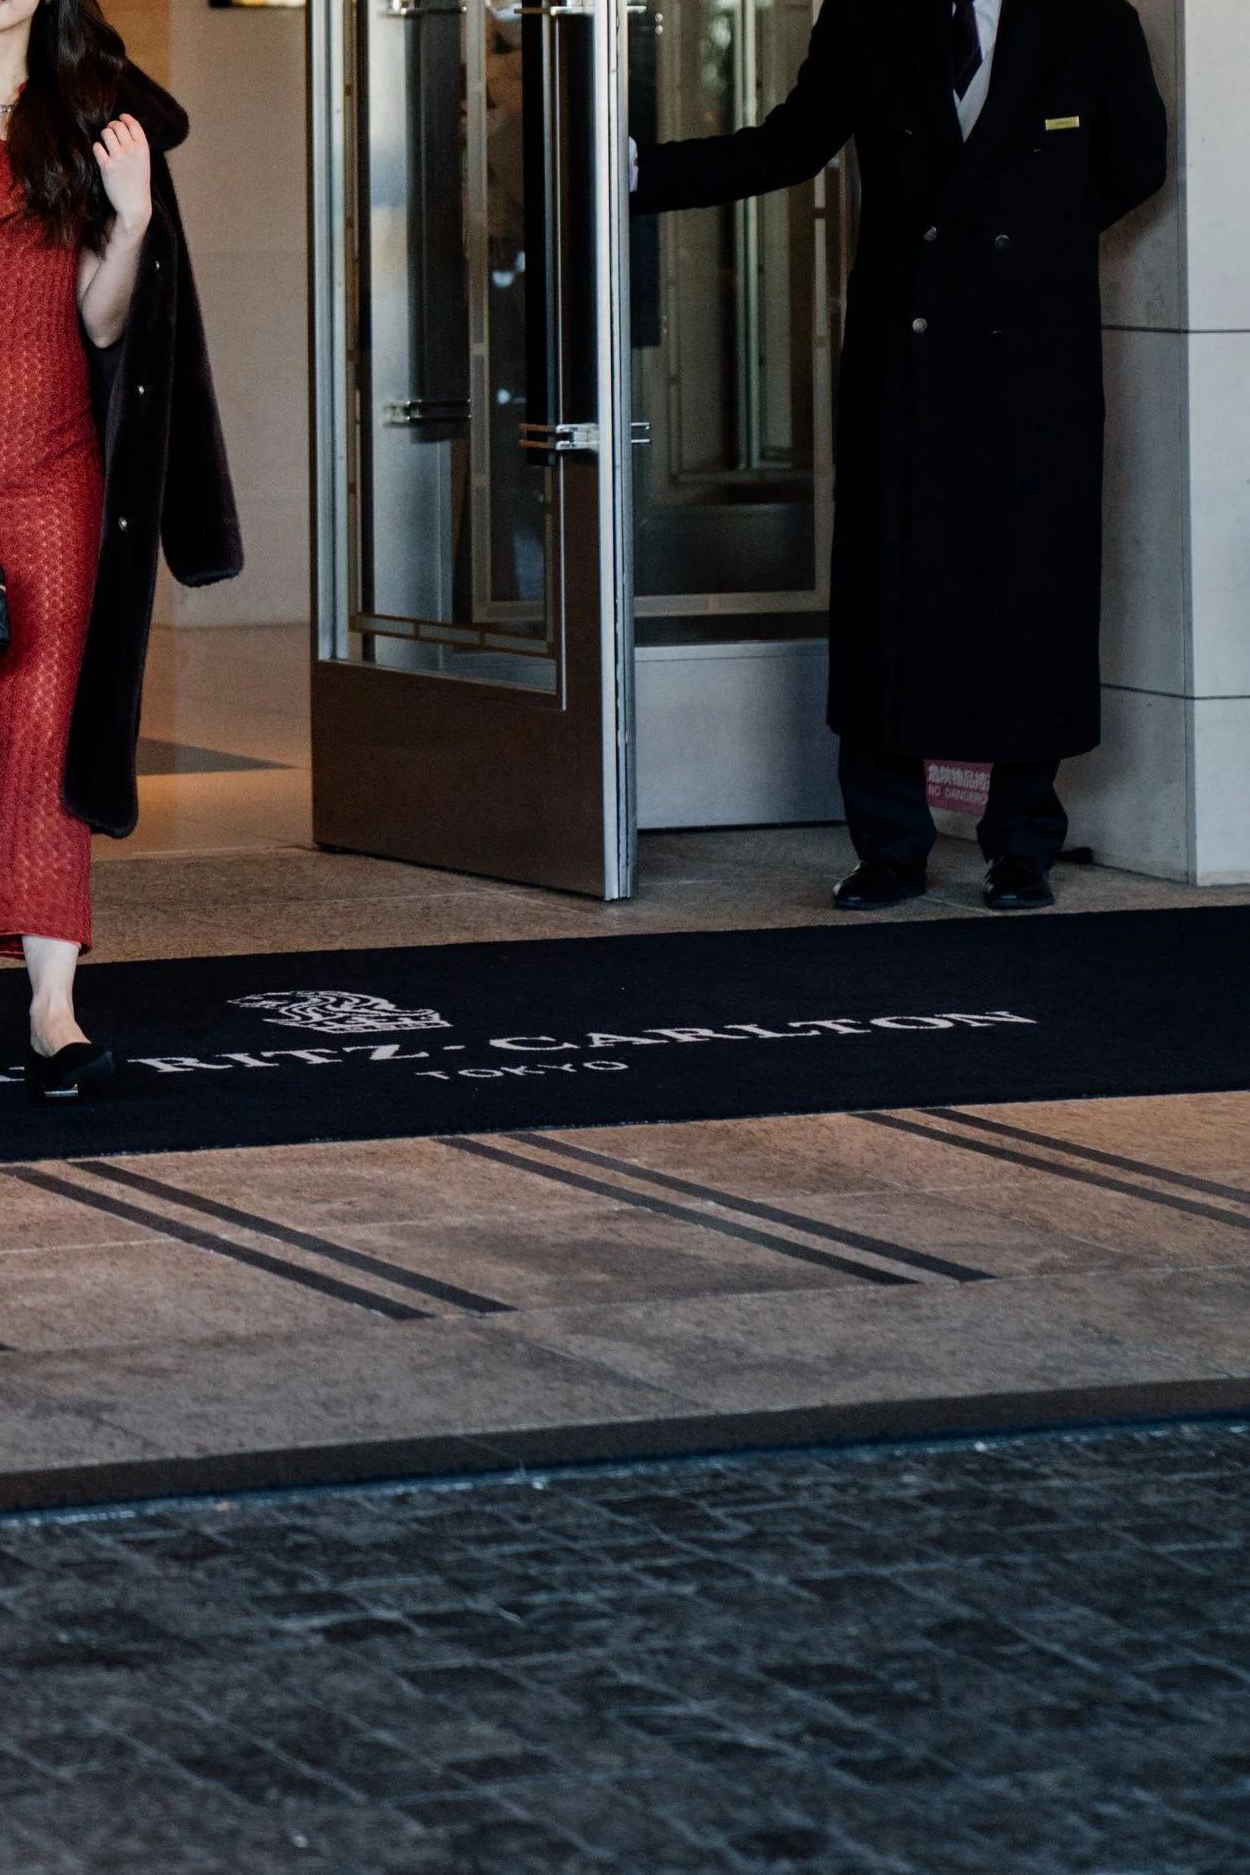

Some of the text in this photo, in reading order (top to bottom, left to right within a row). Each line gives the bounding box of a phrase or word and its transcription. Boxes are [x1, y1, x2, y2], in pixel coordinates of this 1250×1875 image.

[928, 783, 942, 798] NO
[126, 1010, 1038, 1073] RITZ-CARLTON
[415, 1060, 630, 1080] TOKYO
